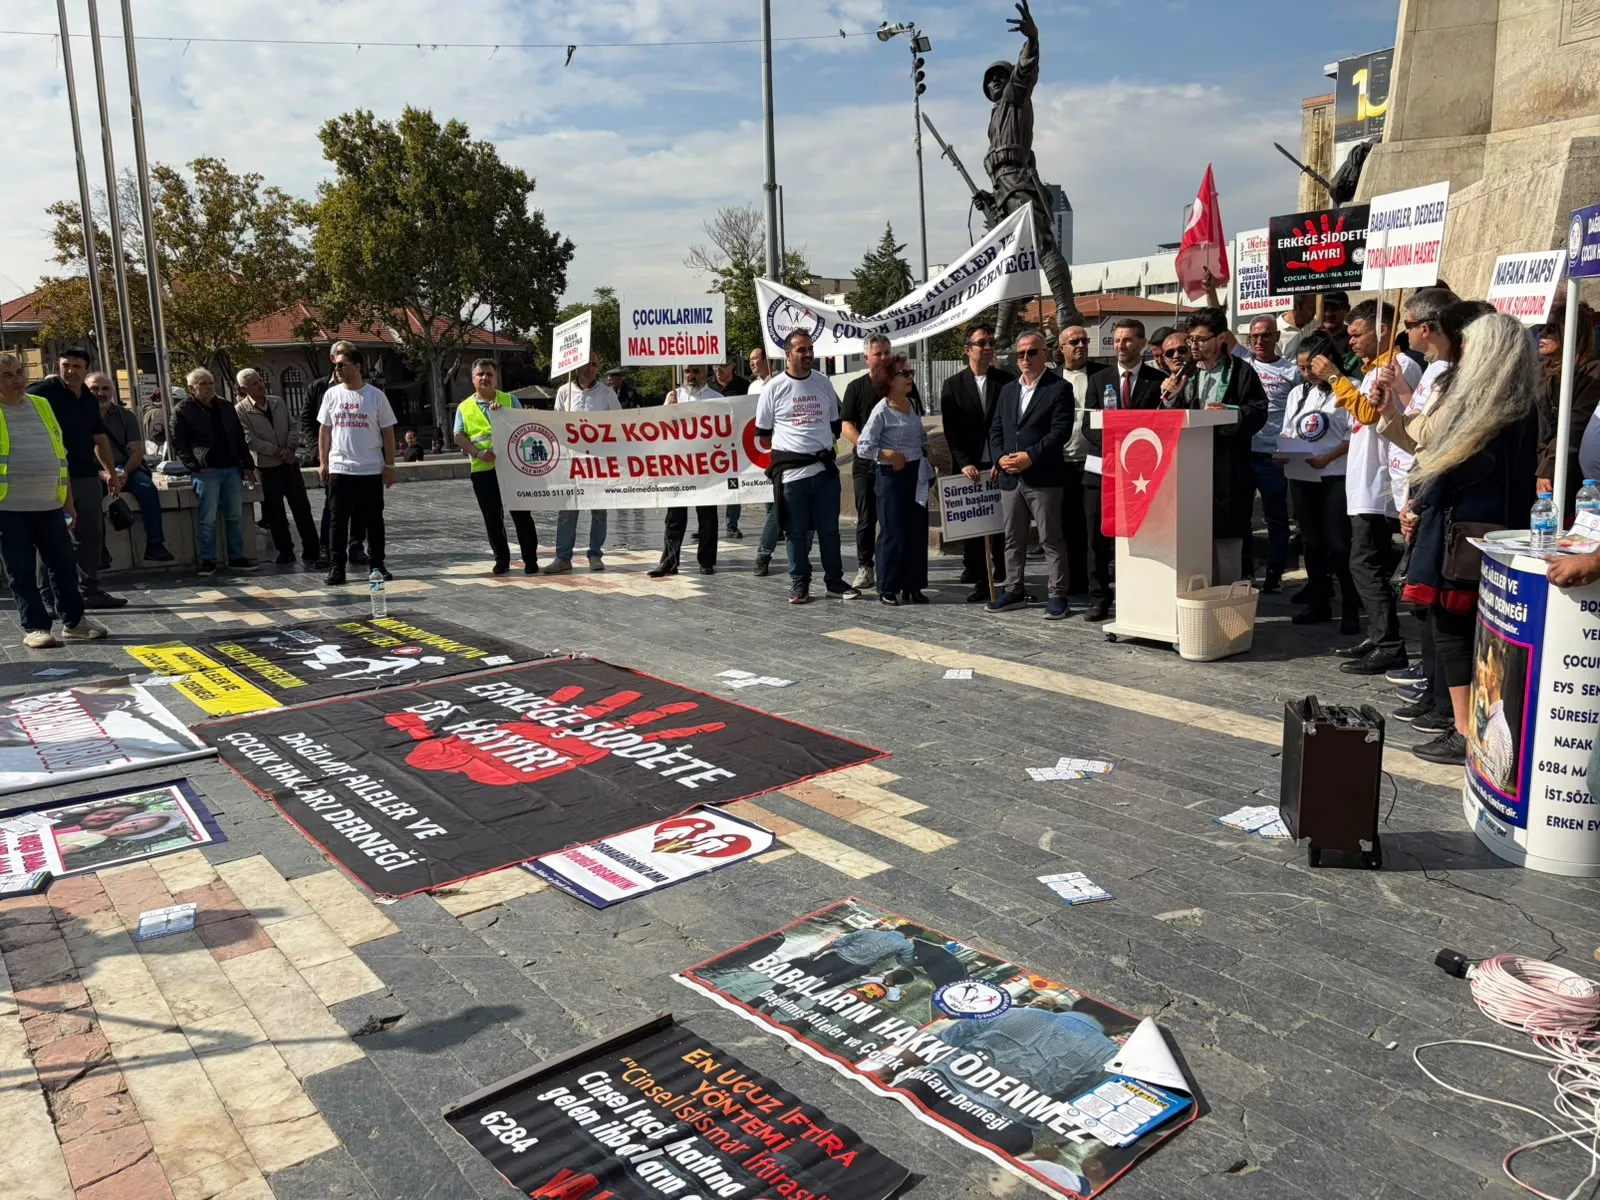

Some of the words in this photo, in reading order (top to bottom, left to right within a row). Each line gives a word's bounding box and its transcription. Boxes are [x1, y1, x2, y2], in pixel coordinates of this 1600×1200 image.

[1414, 201, 1445, 226] DEDELER
[1277, 234, 1318, 249] ERKEĞE
[1321, 229, 1369, 247] ŞİDDETE
[1302, 248, 1340, 262] HAYIR!
[1413, 240, 1441, 265] HASRET
[1238, 265, 1263, 276] SÜRESİZ
[1284, 274, 1307, 283] ÇOCUK
[1494, 260, 1528, 286] NAFAKA
[1526, 252, 1560, 283] HAPSİ
[895, 291, 964, 331] HAKLARI
[967, 246, 1037, 301] DERNEĞİ
[1240, 280, 1268, 292] EVLEN
[1240, 290, 1268, 300] APTALL
[1239, 299, 1273, 311] KÖLELİĞE
[1275, 298, 1291, 306] SON
[633, 307, 713, 330] ÇOCUKLARIMIZ
[628, 335, 655, 357] MAL
[658, 331, 720, 356] DEĞİLDİR
[565, 419, 617, 444] SÖZ
[621, 415, 733, 442] KONUSU
[569, 450, 621, 480] AİLE
[627, 443, 738, 478] DERNEĞİ
[604, 484, 697, 495] www.ailemedokunma.com
[965, 493, 1000, 508] başlang
[945, 499, 963, 509] Yeni
[946, 504, 995, 523] Engeldir!
[1507, 578, 1519, 596] VE
[1494, 602, 1528, 623] DERNEĞİ
[1580, 600, 1600, 616] BOŞ
[1553, 681, 1574, 694] EYS
[1550, 706, 1600, 724] SÜRESİZ
[442, 718, 574, 772] HAYIR!
[464, 681, 594, 728] ERKEĞE
[550, 719, 736, 789] ŞİDDETE
[1554, 736, 1593, 751] NAFAK
[1538, 760, 1568, 775] 6284
[278, 731, 358, 778] DAĞILMIŞ
[339, 773, 418, 822] AİLELER
[405, 816, 448, 840] VE
[217, 731, 282, 771] ÇOCUK
[321, 807, 427, 873] DERNEĞİ
[1546, 815, 1584, 831] ERKEN
[748, 953, 882, 1024] BABALARIN
[869, 1017, 953, 1064] HAKKI
[950, 1051, 1097, 1145] ÖDENMEZ
[759, 988, 811, 1021] Dağılmış
[805, 1009, 847, 1039] Aileler
[843, 1034, 862, 1048] ve
[856, 1042, 905, 1071] Çocuk
[898, 1066, 954, 1100] Hakları
[948, 1090, 1014, 1132] Derneği
[536, 1086, 603, 1126] gelen
[681, 1047, 721, 1074] EN
[717, 1069, 786, 1114] UCUZ
[776, 1106, 859, 1169] İFTİRA
[690, 1079, 796, 1153] YÖNTEMİ
[479, 1110, 540, 1154] 6284
[577, 1070, 647, 1114] Cinsel
[664, 1135, 747, 1198] hattına
